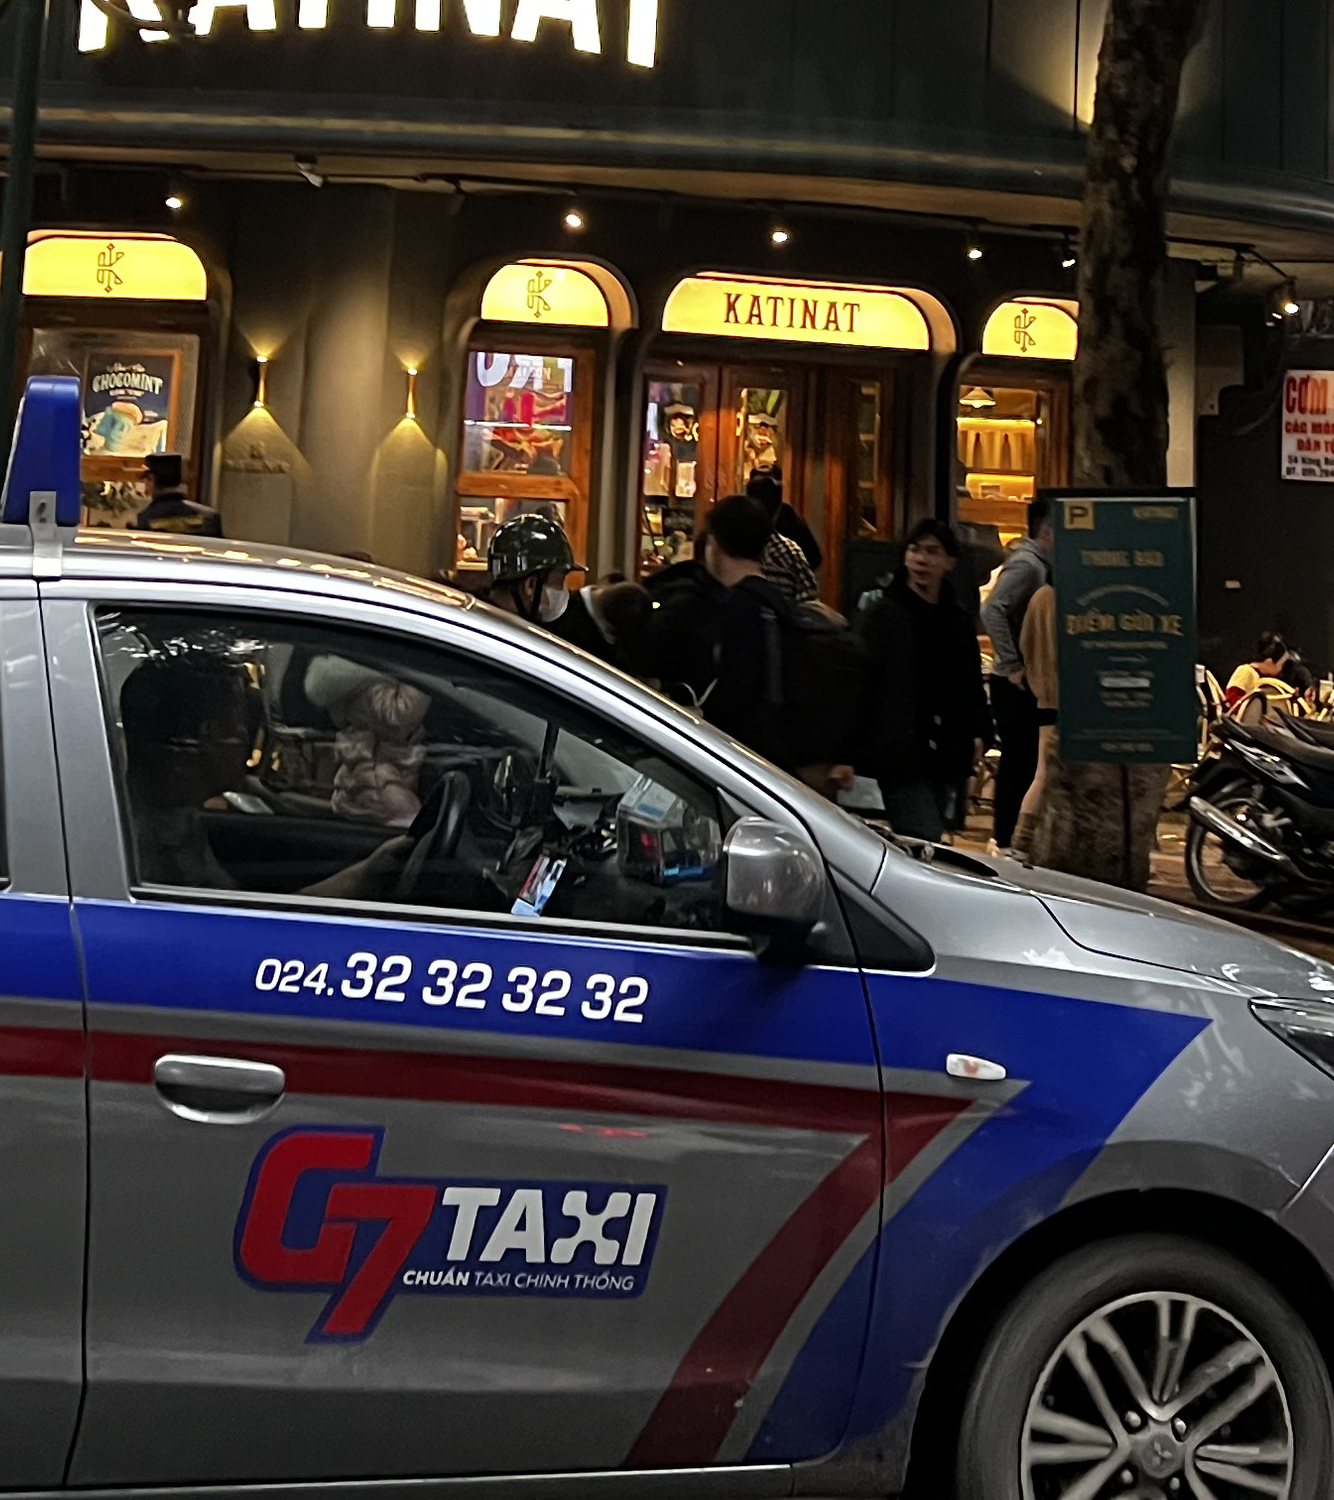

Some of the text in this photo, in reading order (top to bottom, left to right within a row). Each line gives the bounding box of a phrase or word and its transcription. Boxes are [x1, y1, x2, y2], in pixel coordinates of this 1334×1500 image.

[723, 292, 861, 333] KATINAT
[92, 372, 164, 395] CHOCOMINT
[1286, 374, 1328, 415] CƠM
[1069, 506, 1089, 525] P
[421, 959, 493, 1010] 32
[501, 965, 572, 1016] 32
[580, 972, 650, 1023] 32
[442, 1187, 657, 1265] TAXI
[474, 1271, 511, 1287] TAXI
